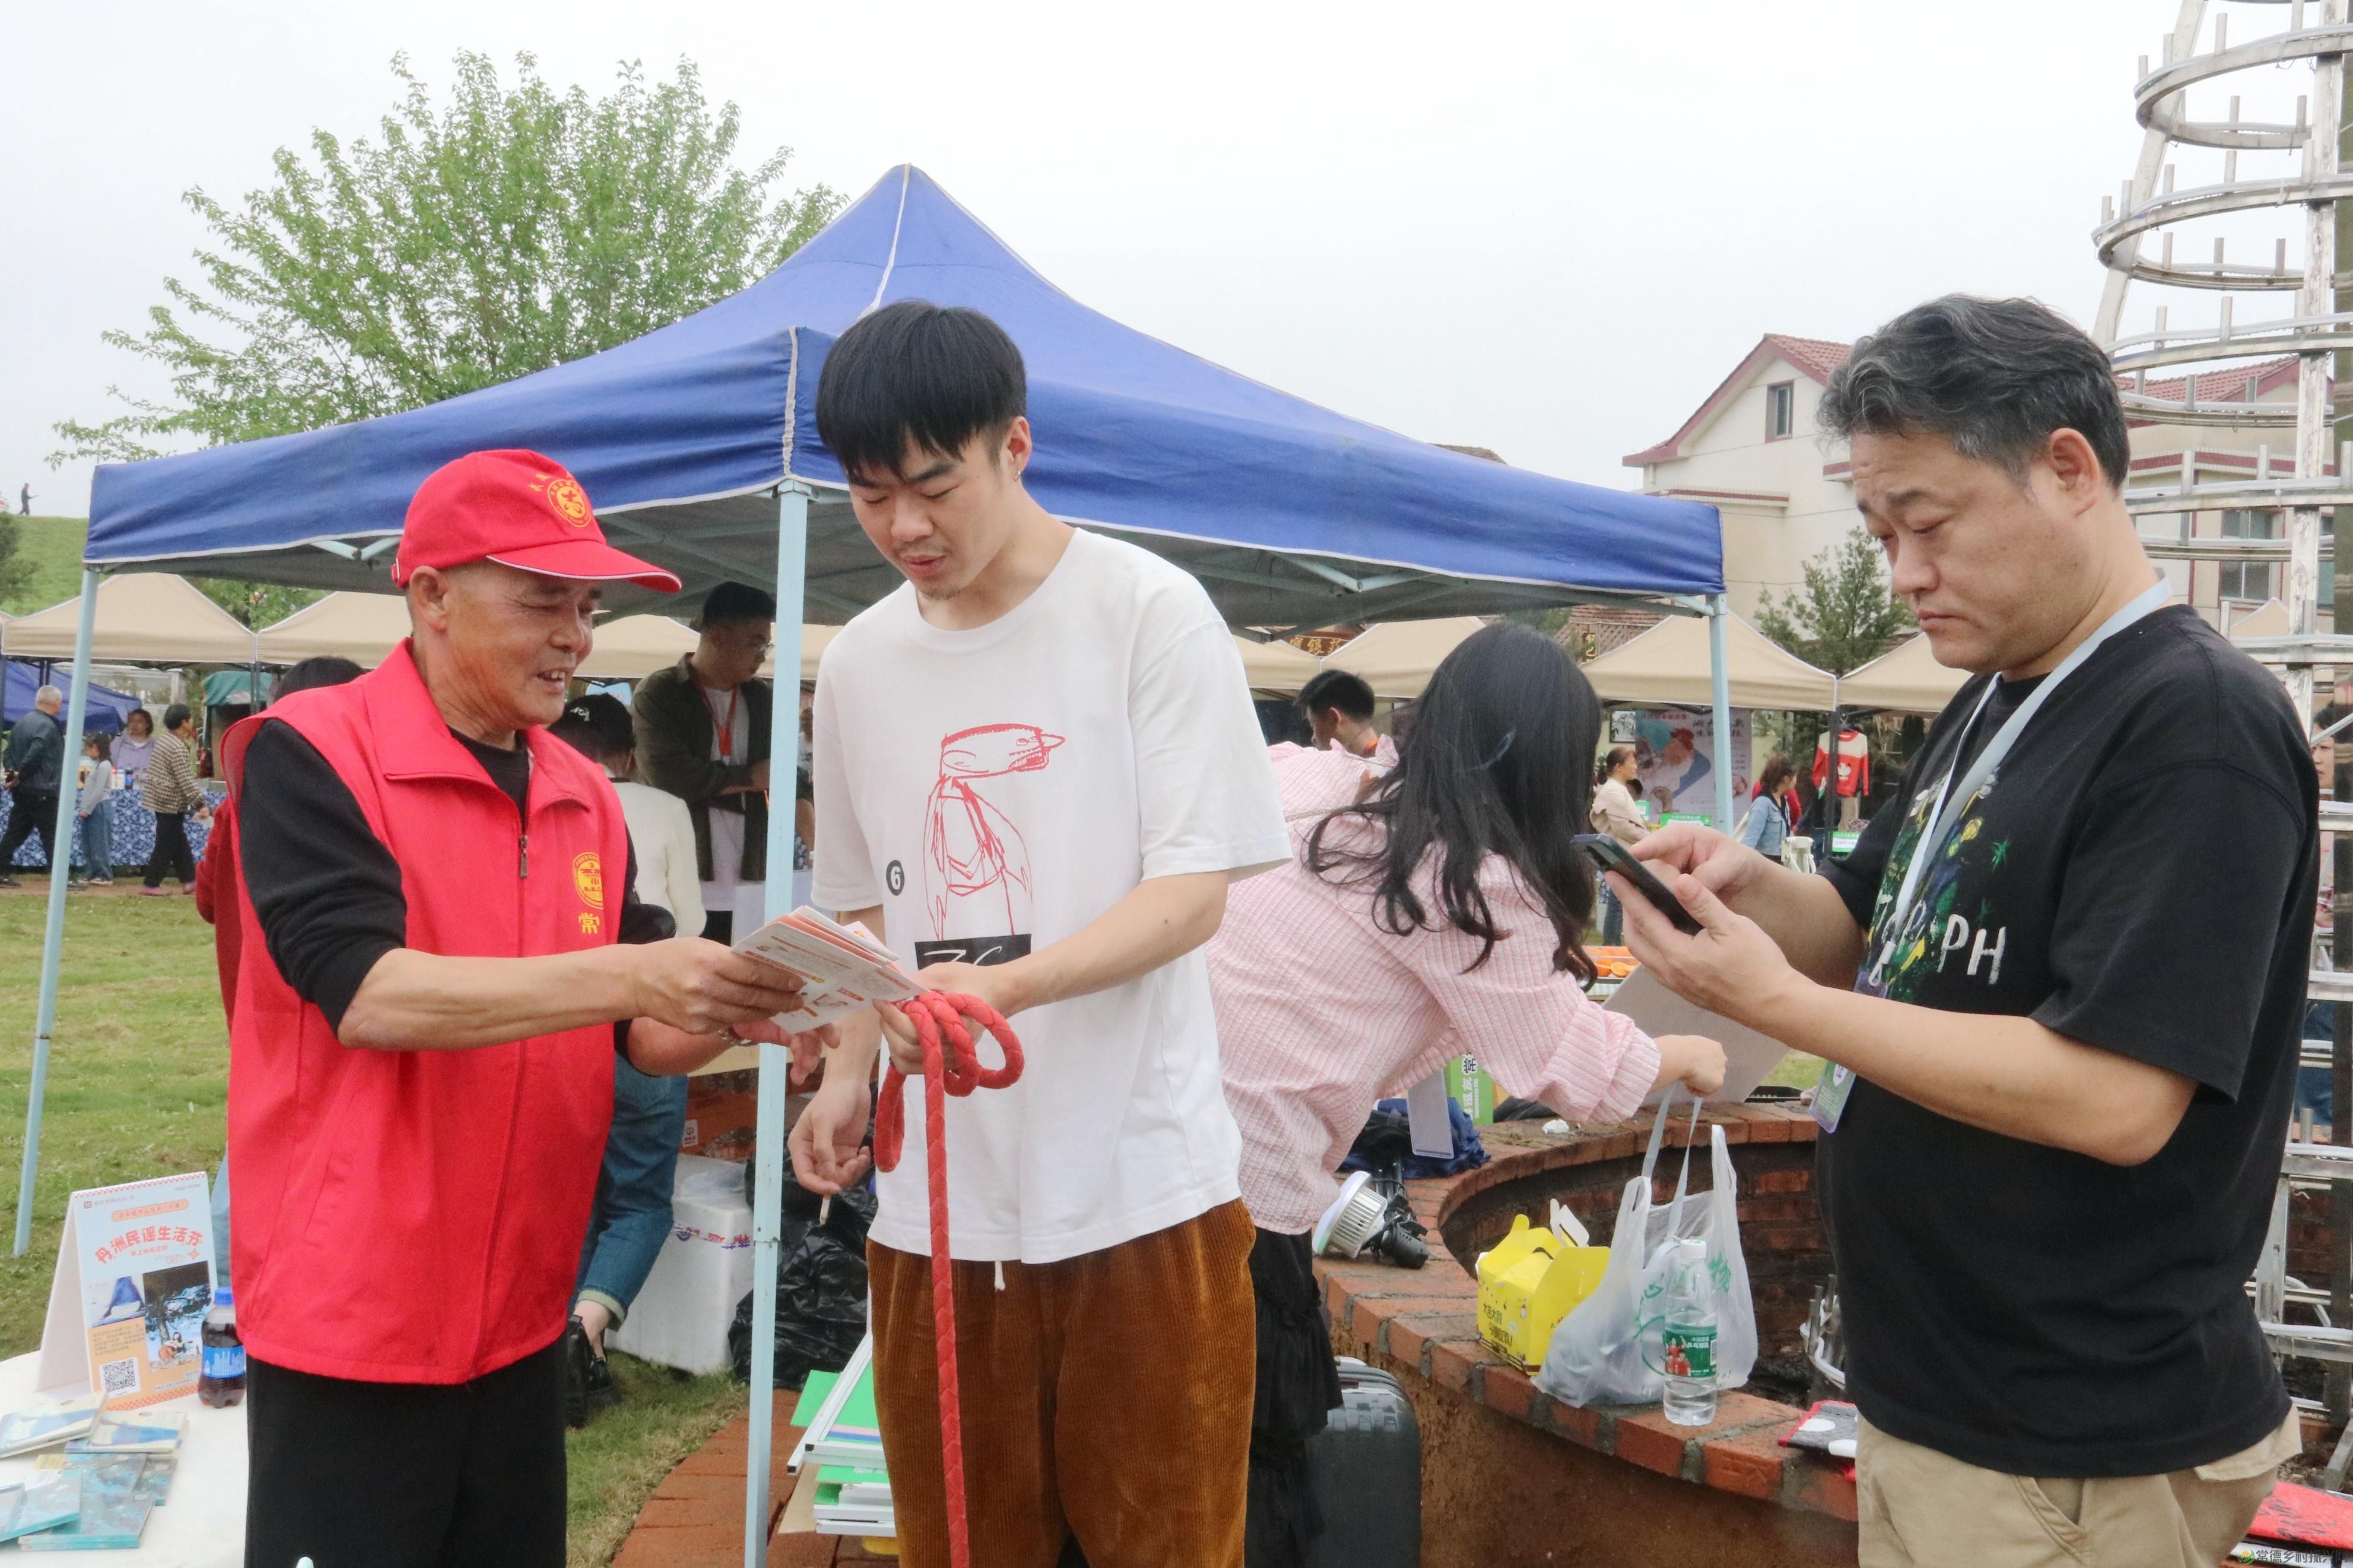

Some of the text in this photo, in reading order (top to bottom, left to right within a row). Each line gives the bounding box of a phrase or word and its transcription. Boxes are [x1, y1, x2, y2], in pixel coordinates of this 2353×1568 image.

[891, 866, 901, 890] 6
[1462, 1052, 1477, 1074] 常
[95, 1225, 203, 1264] 丹洲民谣生活节
